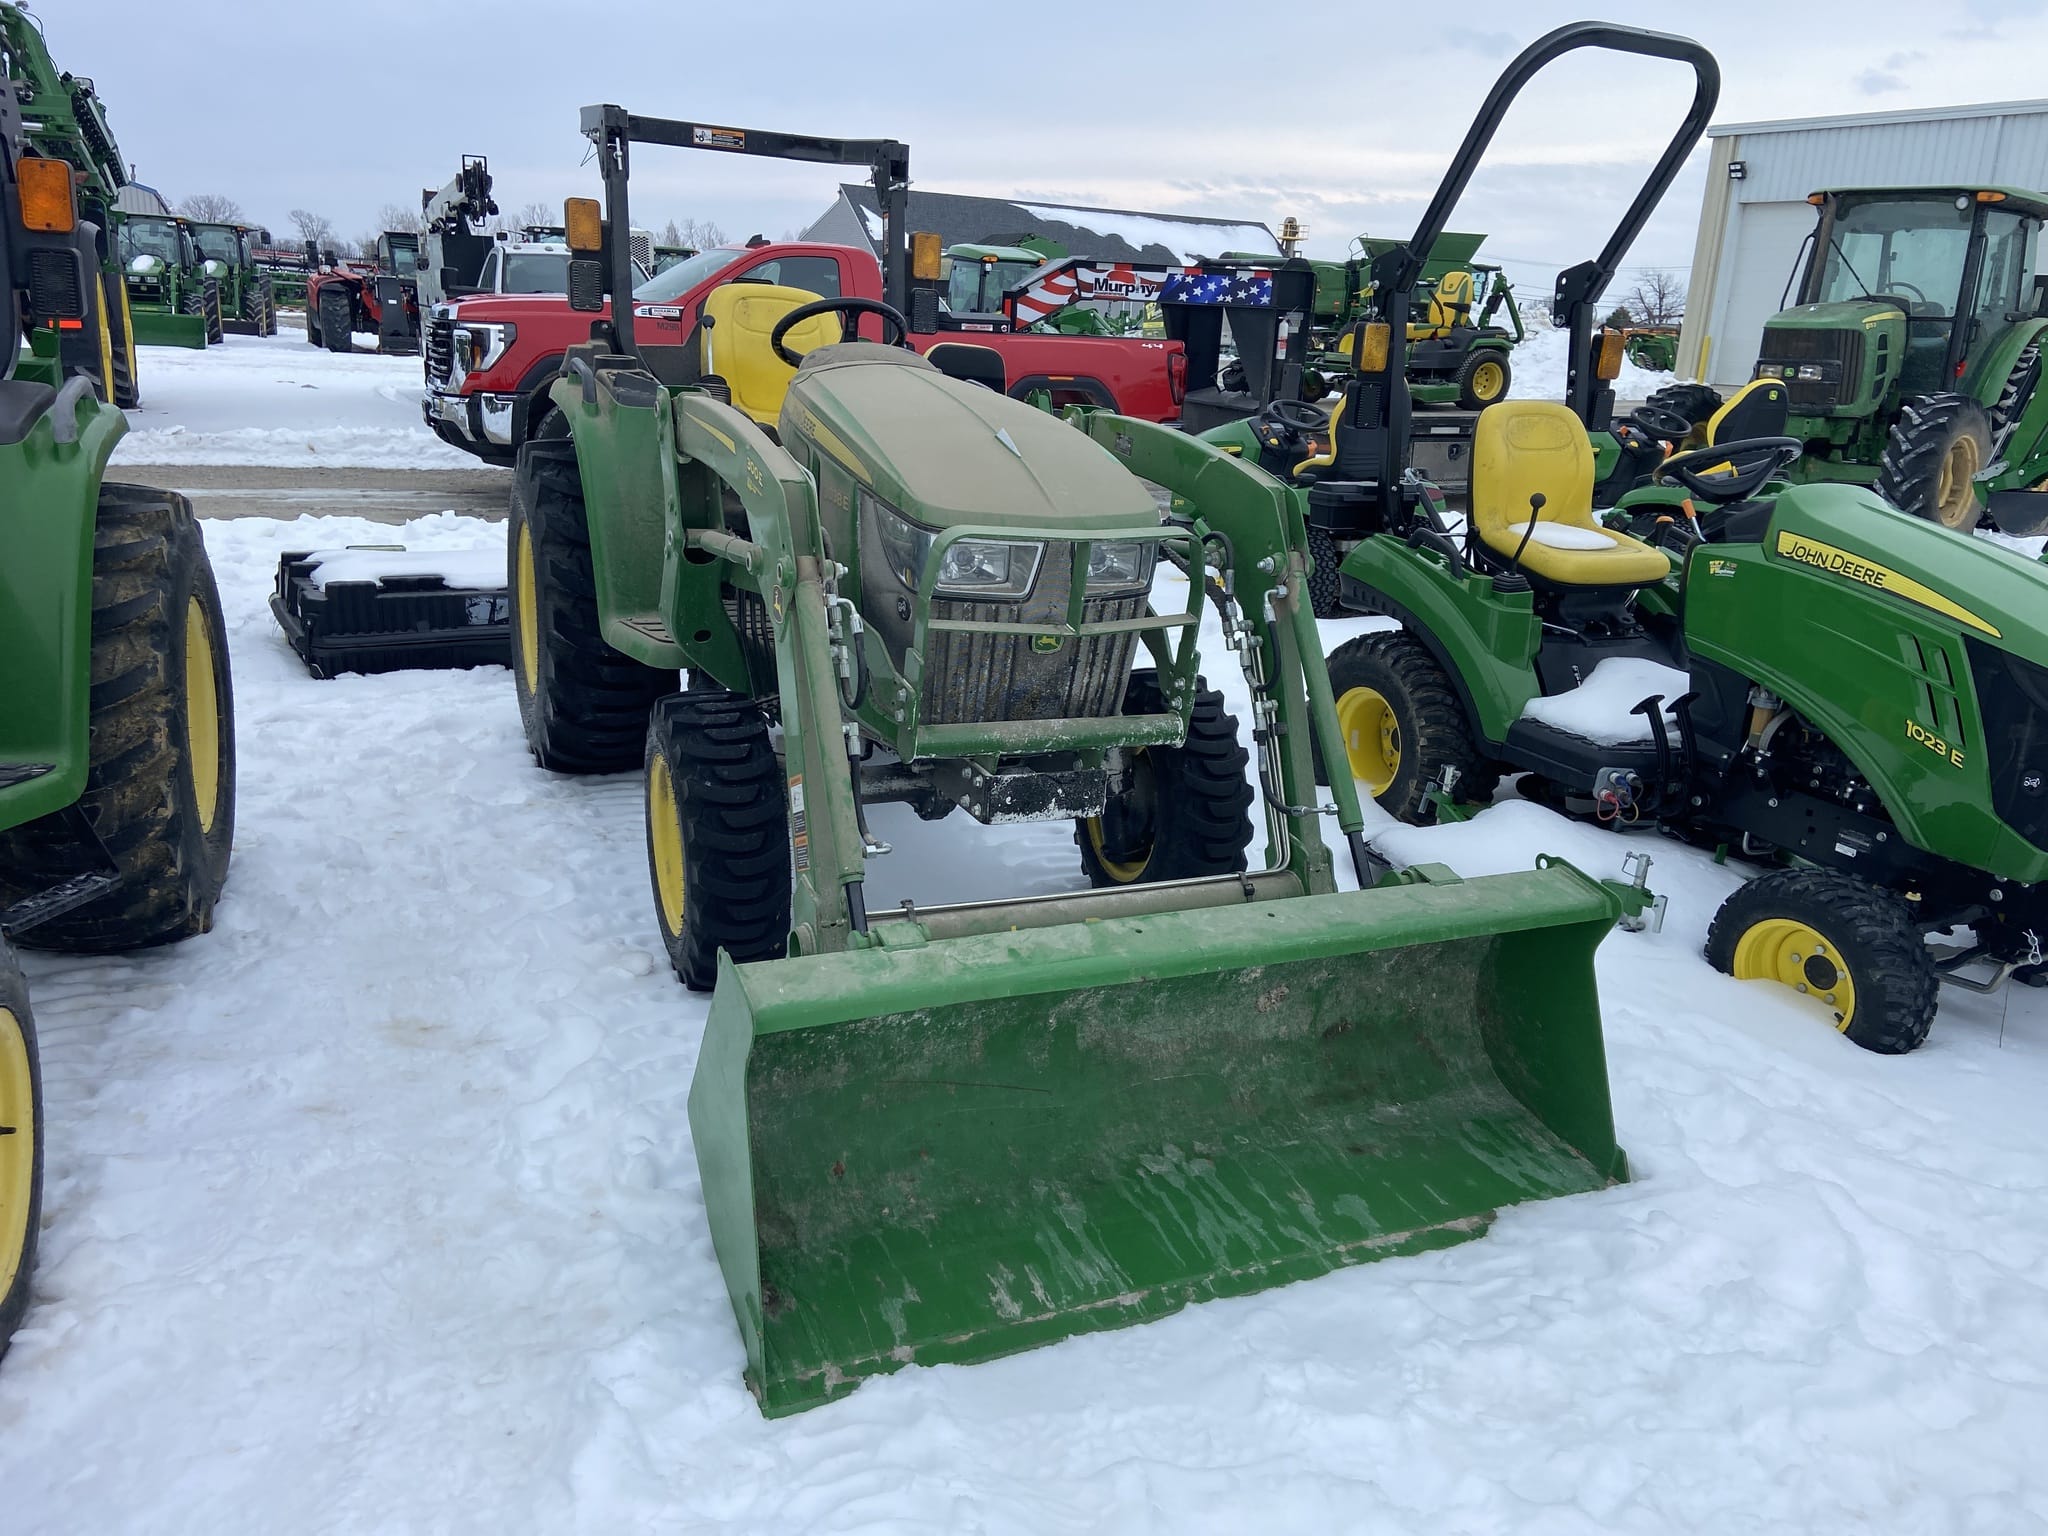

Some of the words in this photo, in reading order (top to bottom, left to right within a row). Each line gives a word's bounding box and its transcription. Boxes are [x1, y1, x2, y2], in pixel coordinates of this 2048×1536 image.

[1094, 277, 1157, 297] Murphy
[1785, 541, 1830, 568] JOHN
[1829, 553, 1888, 588] DEERE
[1905, 719, 1947, 756] 1023
[1950, 748, 1965, 769] E
